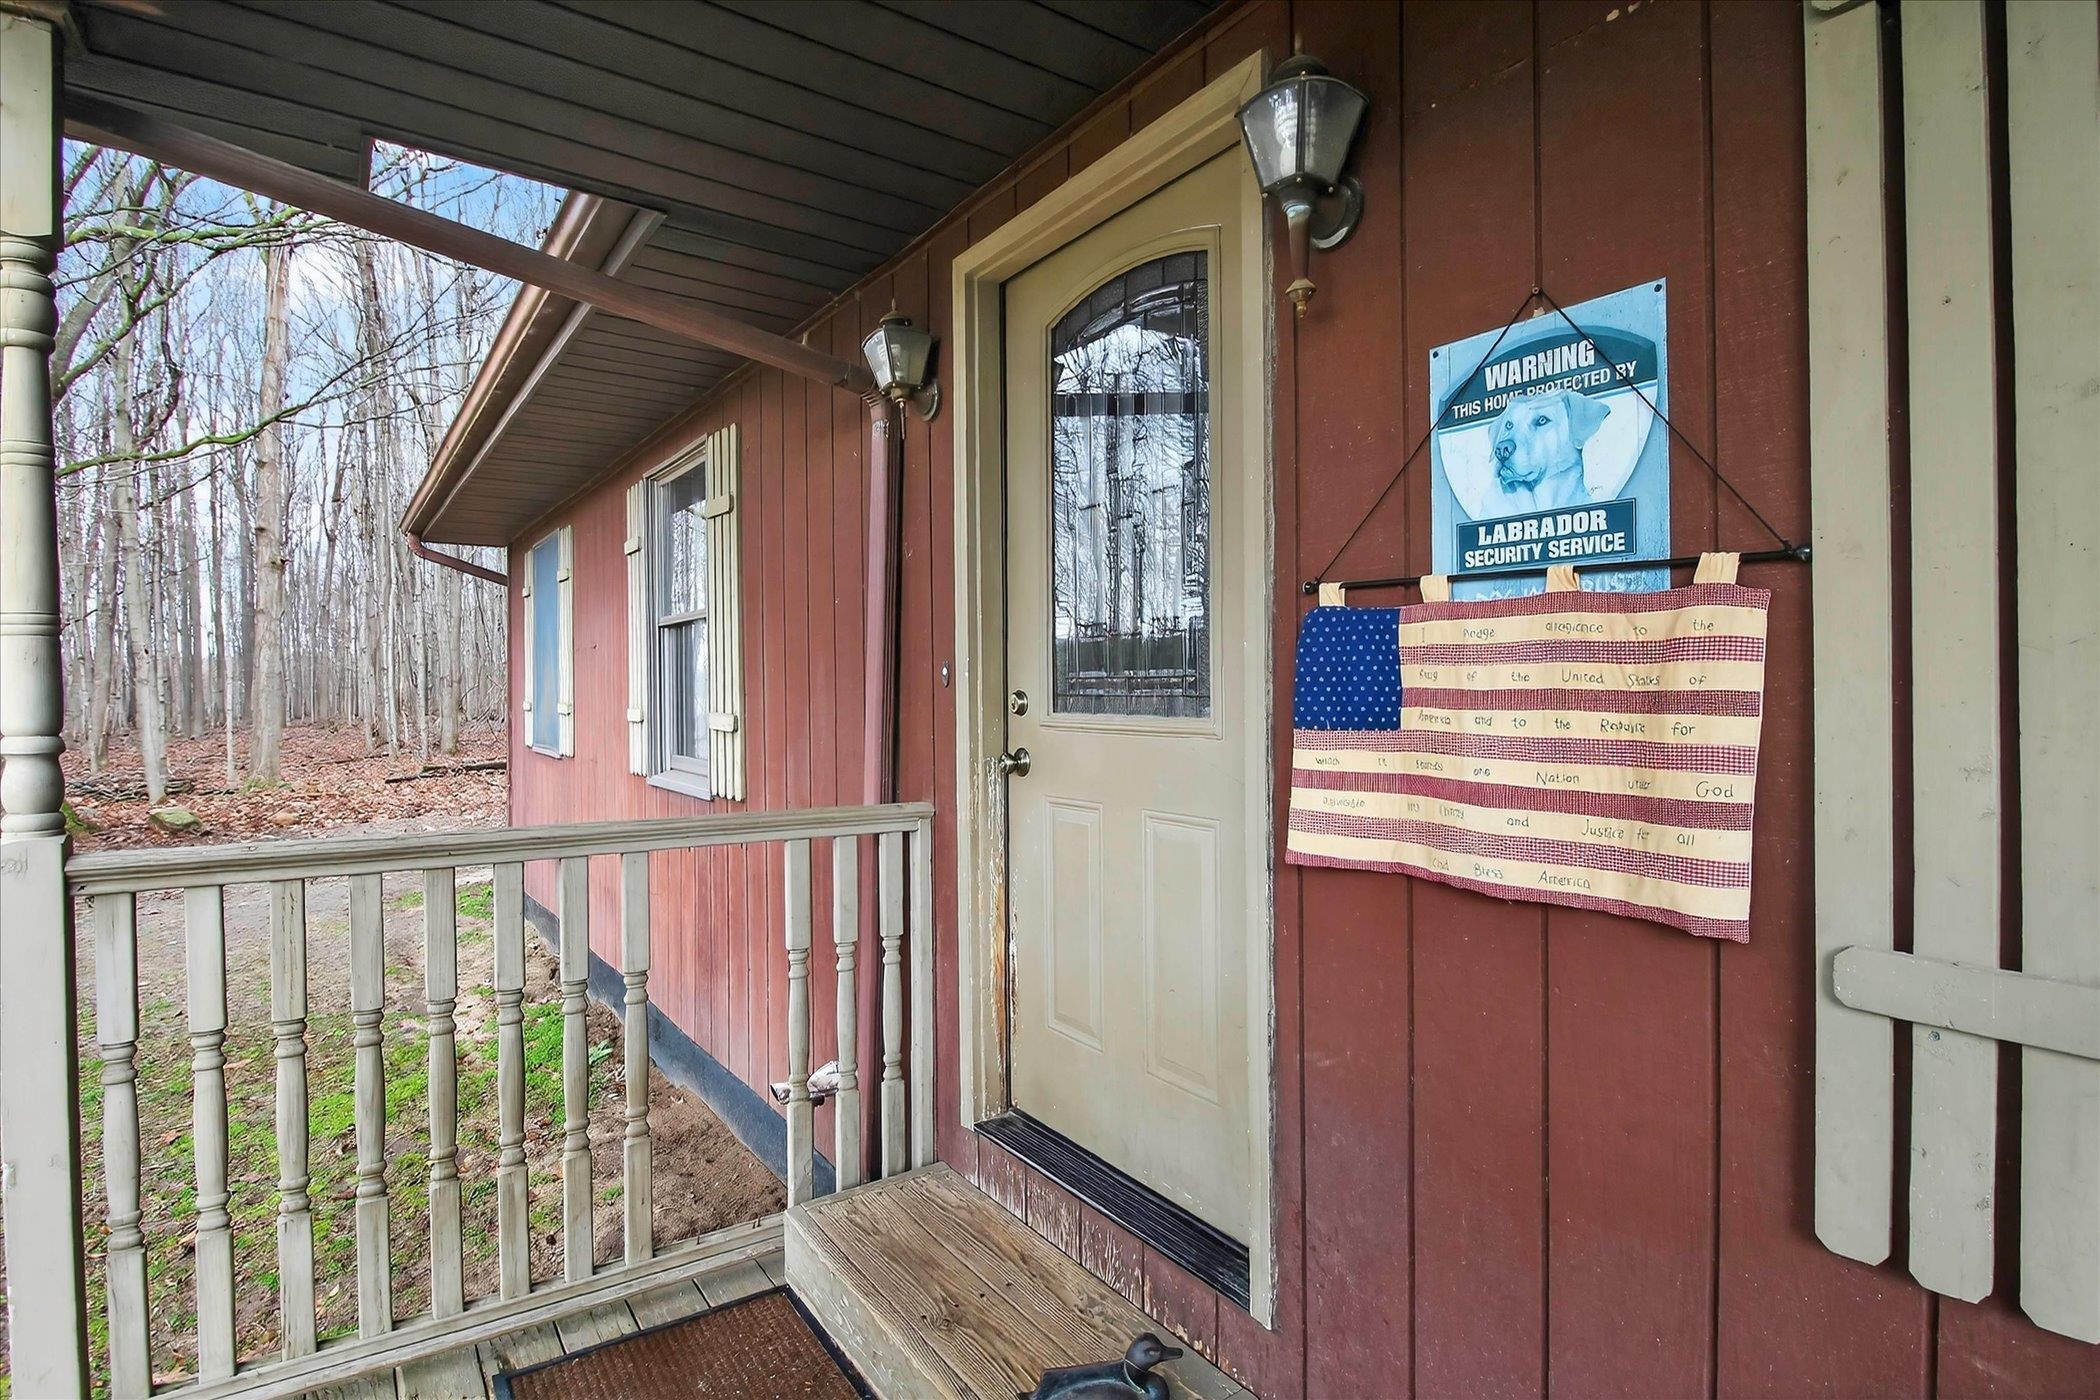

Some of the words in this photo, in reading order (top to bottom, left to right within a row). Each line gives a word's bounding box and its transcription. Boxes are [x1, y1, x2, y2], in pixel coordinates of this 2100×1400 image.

[1484, 338, 1595, 392] WARNING
[1452, 400, 1481, 419] THIS
[1527, 367, 1611, 397] PROTECTED
[1615, 360, 1637, 380] BY
[1478, 509, 1608, 546] LABRADOR
[1464, 541, 1544, 569] SECURITY
[1548, 532, 1626, 558] SERVICE
[1633, 625, 1648, 637] to
[1692, 619, 1714, 631] the
[1688, 674, 1707, 685] of
[1474, 716, 1493, 727] and
[1511, 717, 1527, 729] to
[1554, 717, 1572, 730] the
[1671, 722, 1696, 736] for
[1536, 771, 1580, 785] Nation
[1695, 780, 1734, 799] God
[1506, 816, 1530, 828] and
[1580, 818, 1625, 839] Justice
[1676, 833, 1696, 847] all
[1537, 870, 1592, 890] America
